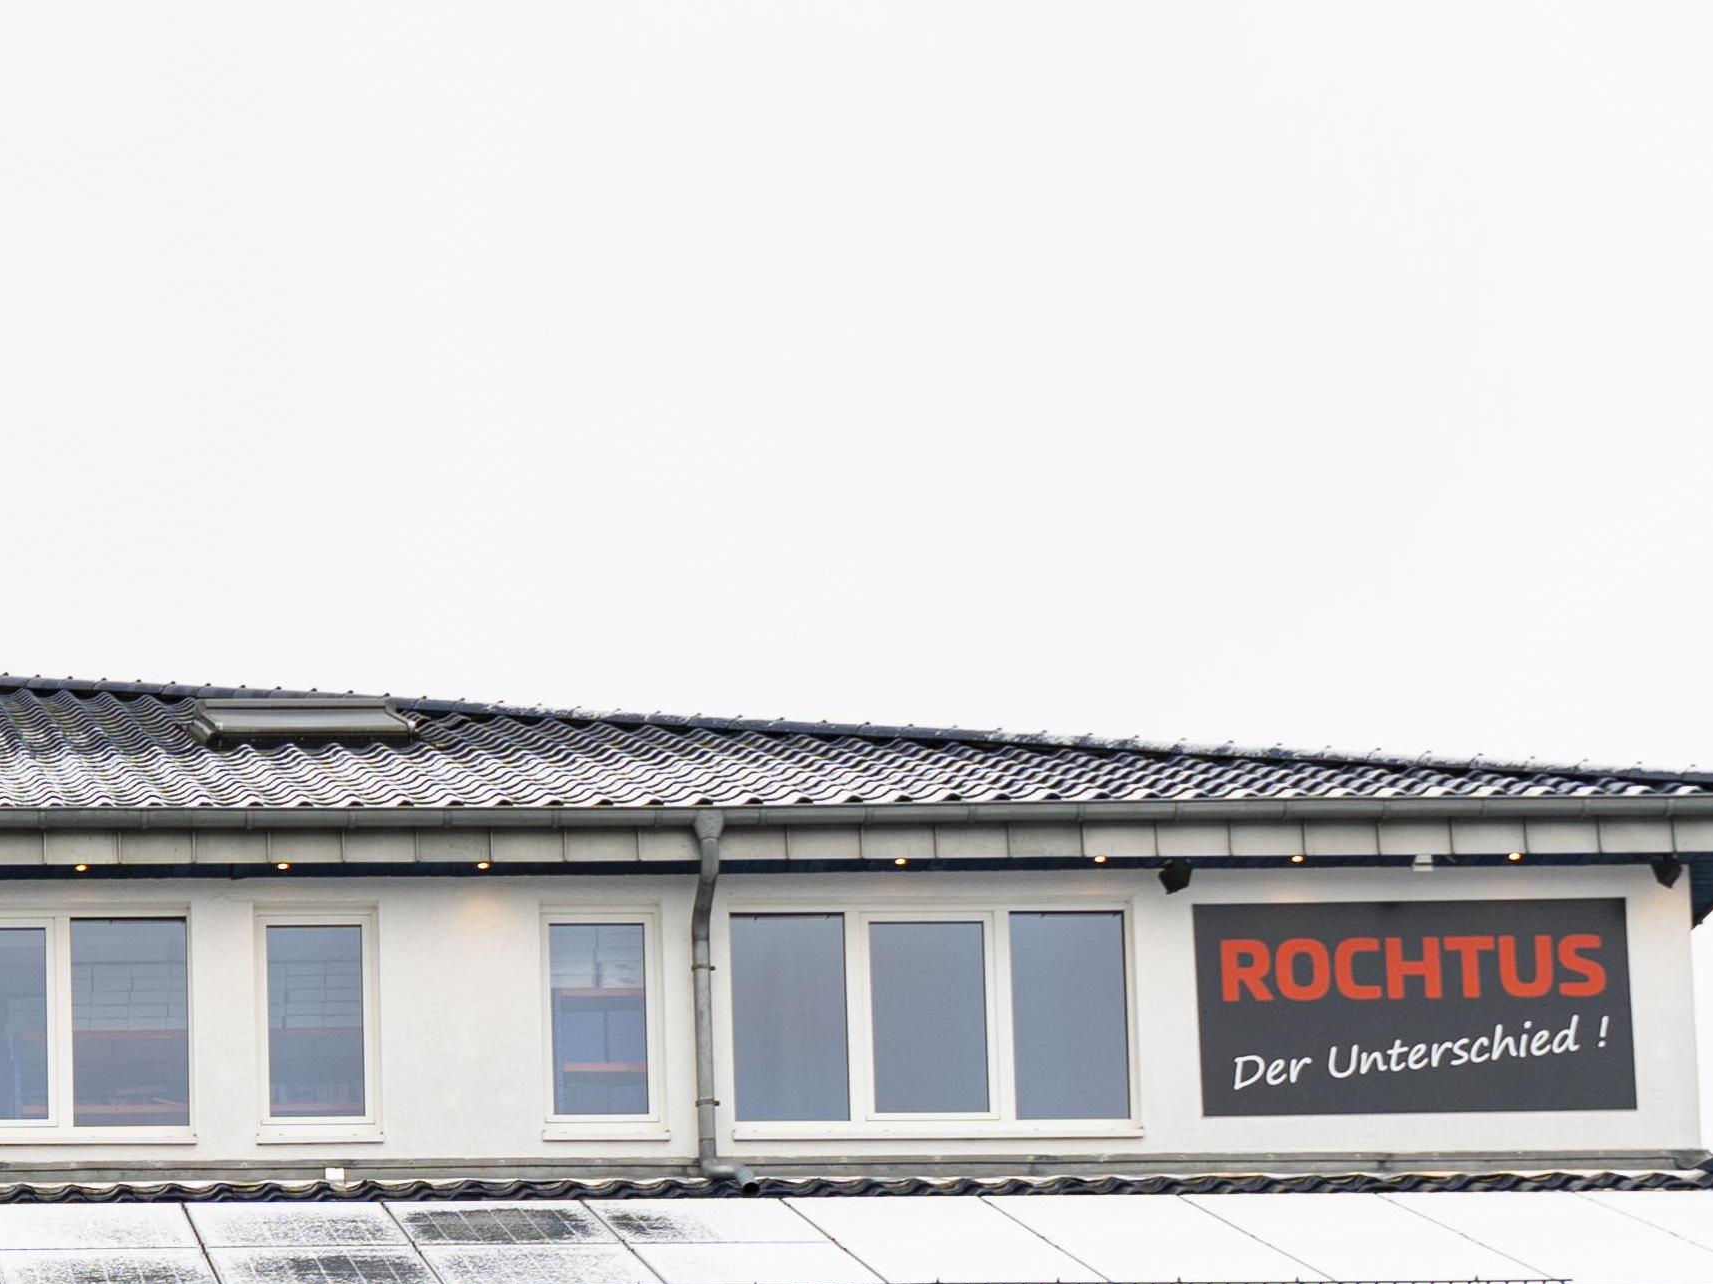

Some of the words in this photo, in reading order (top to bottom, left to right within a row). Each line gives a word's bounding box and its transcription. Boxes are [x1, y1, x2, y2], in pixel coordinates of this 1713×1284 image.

[1220, 933, 1607, 1001] ROCHTUS
[1232, 1054, 1312, 1091] Der
[1327, 1014, 1580, 1076] Unterschied
